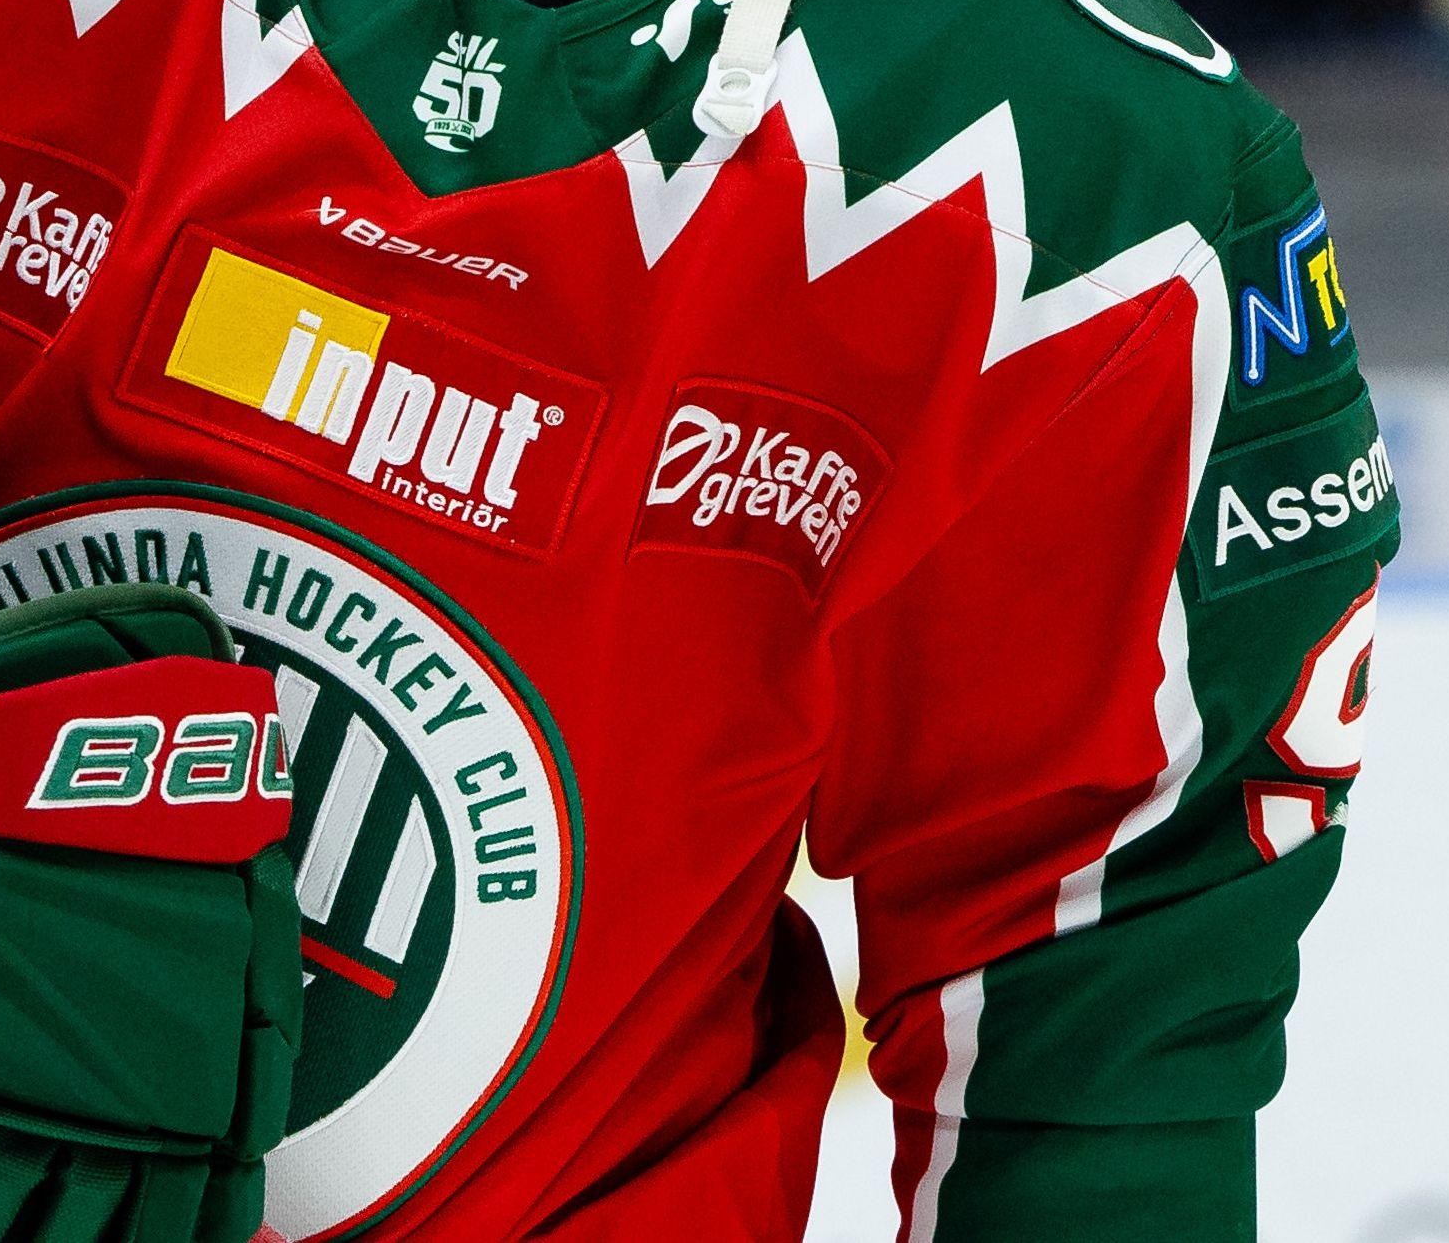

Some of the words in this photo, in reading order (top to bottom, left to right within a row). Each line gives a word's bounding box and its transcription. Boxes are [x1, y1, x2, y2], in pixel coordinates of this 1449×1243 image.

[412, 60, 503, 138] 50
[7, 182, 113, 275] Kaff
[261, 309, 541, 510] input
[381, 468, 508, 533] interiör
[692, 473, 841, 568] greven
[740, 427, 861, 530] Kaffe
[242, 548, 487, 735] HOCKEY
[453, 750, 538, 904] CLUB
